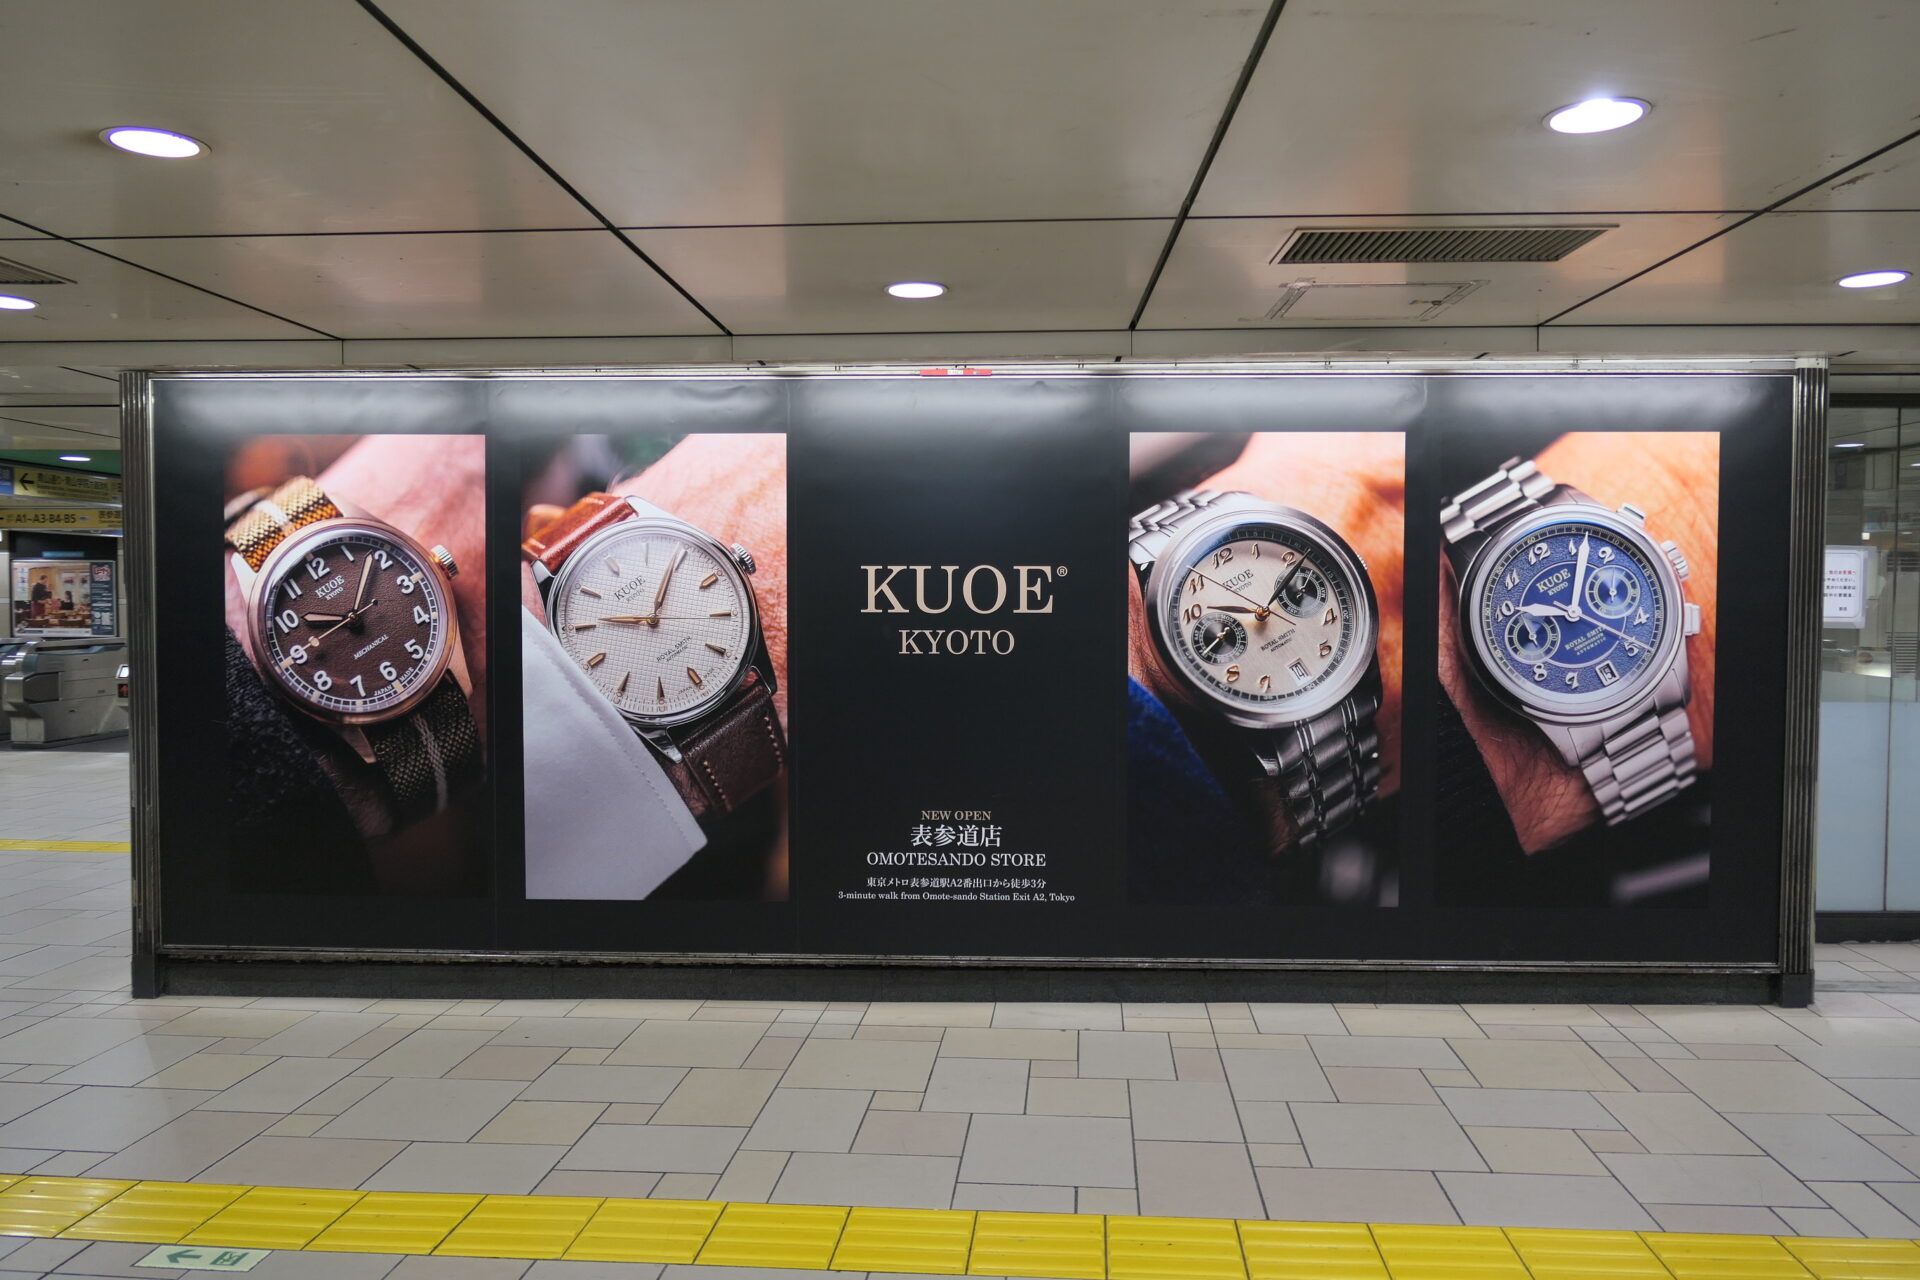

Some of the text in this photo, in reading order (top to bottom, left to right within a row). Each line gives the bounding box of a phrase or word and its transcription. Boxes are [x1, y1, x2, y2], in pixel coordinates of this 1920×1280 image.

[374, 550, 393, 570] 2
[1212, 547, 1233, 569] 12
[1281, 551, 1297, 568] 2
[1528, 542, 1551, 565] 12
[1598, 546, 1616, 564] 2
[305, 557, 331, 580] 12
[283, 578, 302, 600] 11
[314, 575, 345, 599] KUOE
[396, 574, 414, 595] 3
[614, 575, 646, 600] KUOE
[1223, 568, 1254, 591] KUOE
[1535, 568, 1572, 593] KUOE
[1548, 581, 1569, 596] KYOTO
[274, 609, 299, 634] 10
[413, 605, 430, 625] 4
[1183, 603, 1202, 624] 10
[1323, 607, 1338, 625] 4
[1495, 600, 1515, 622] 10
[1633, 606, 1650, 626] 4
[353, 634, 389, 660] MECHANICAL
[404, 639, 423, 660] 5
[898, 629, 1015, 655] KYOTO
[1319, 640, 1332, 659] 5
[1624, 637, 1639, 657] 5
[290, 644, 308, 664] 9
[313, 670, 332, 691] 8
[379, 661, 397, 681] 6
[1226, 665, 1240, 683] 8
[1533, 663, 1548, 682] 8
[350, 675, 366, 697] 7
[921, 810, 992, 821] NEW OPEN
[910, 823, 1003, 848] 表参道店
[866, 851, 1047, 867] OMOTESANDO STORE
[838, 890, 1076, 903] 3-minute walk from Omote-sando Station Exit A2, Tokyo
